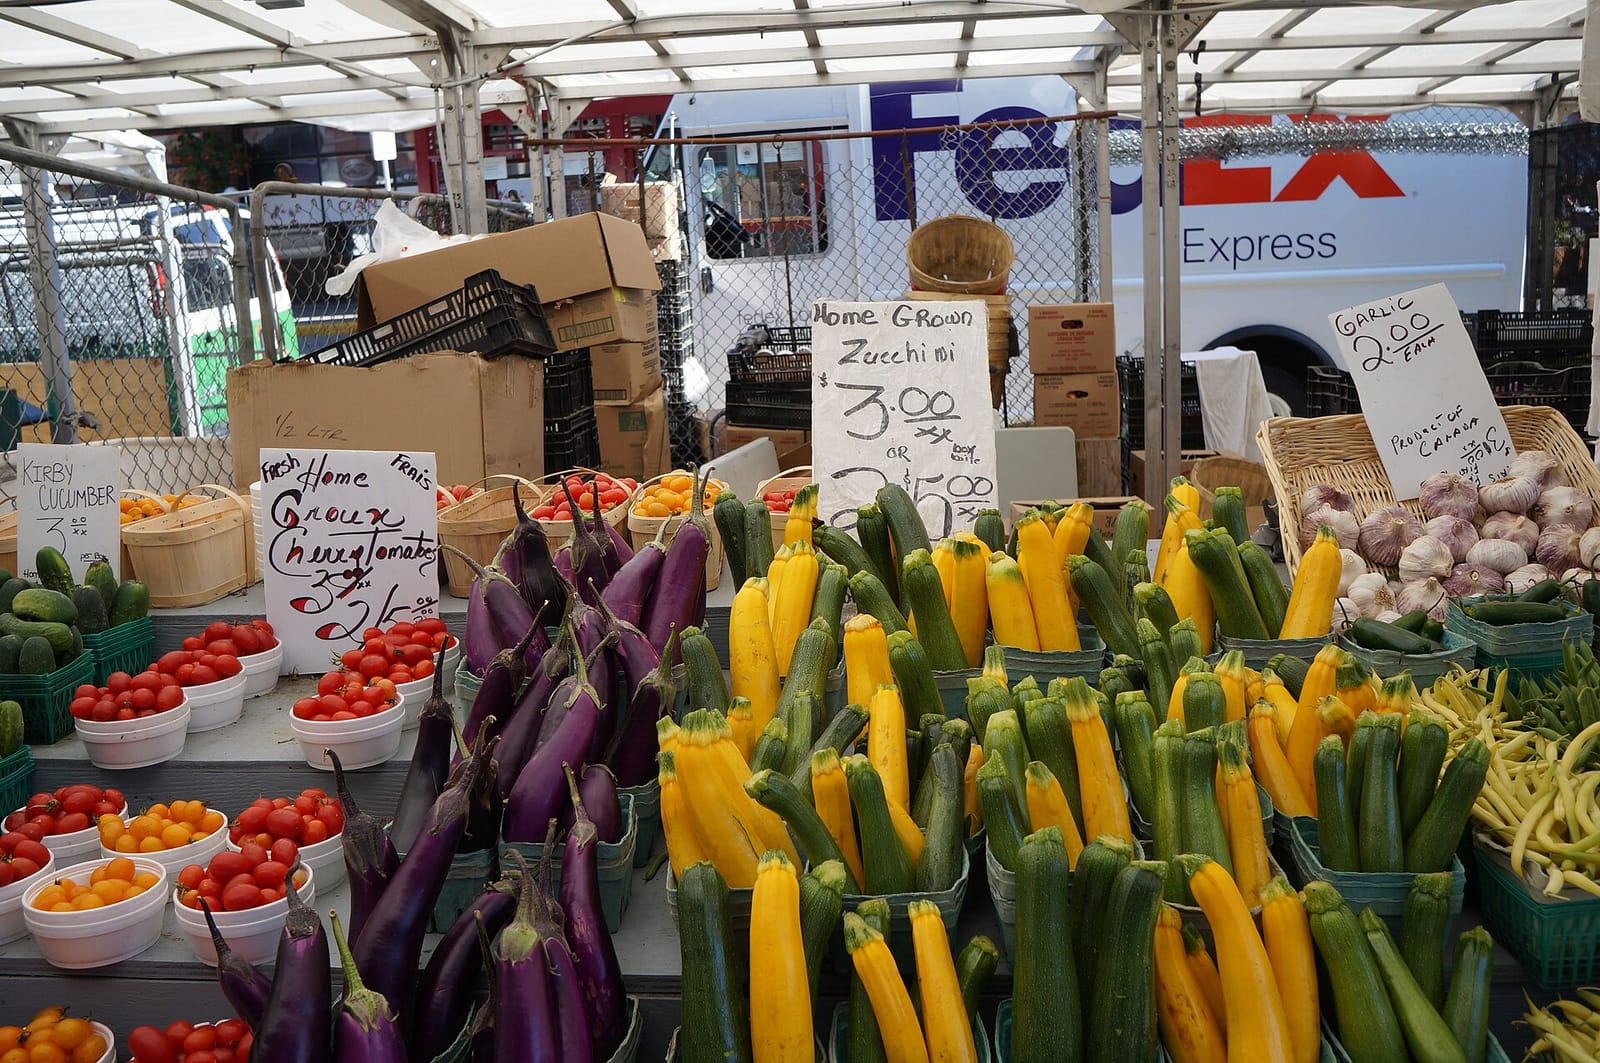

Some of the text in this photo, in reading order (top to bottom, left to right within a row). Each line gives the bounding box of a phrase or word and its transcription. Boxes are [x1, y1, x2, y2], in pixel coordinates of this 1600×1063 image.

[1183, 227, 1336, 270] Express
[737, 308, 812, 327] fedex.co
[814, 303, 878, 327] Home
[838, 338, 955, 366] Zucchini
[275, 410, 347, 441] 1/2 LTR
[1447, 404, 1464, 422] OF
[886, 446, 912, 463] OR
[22, 457, 74, 486] KIRBY
[297, 453, 370, 493] Home
[38, 484, 117, 512] CUCUMBER
